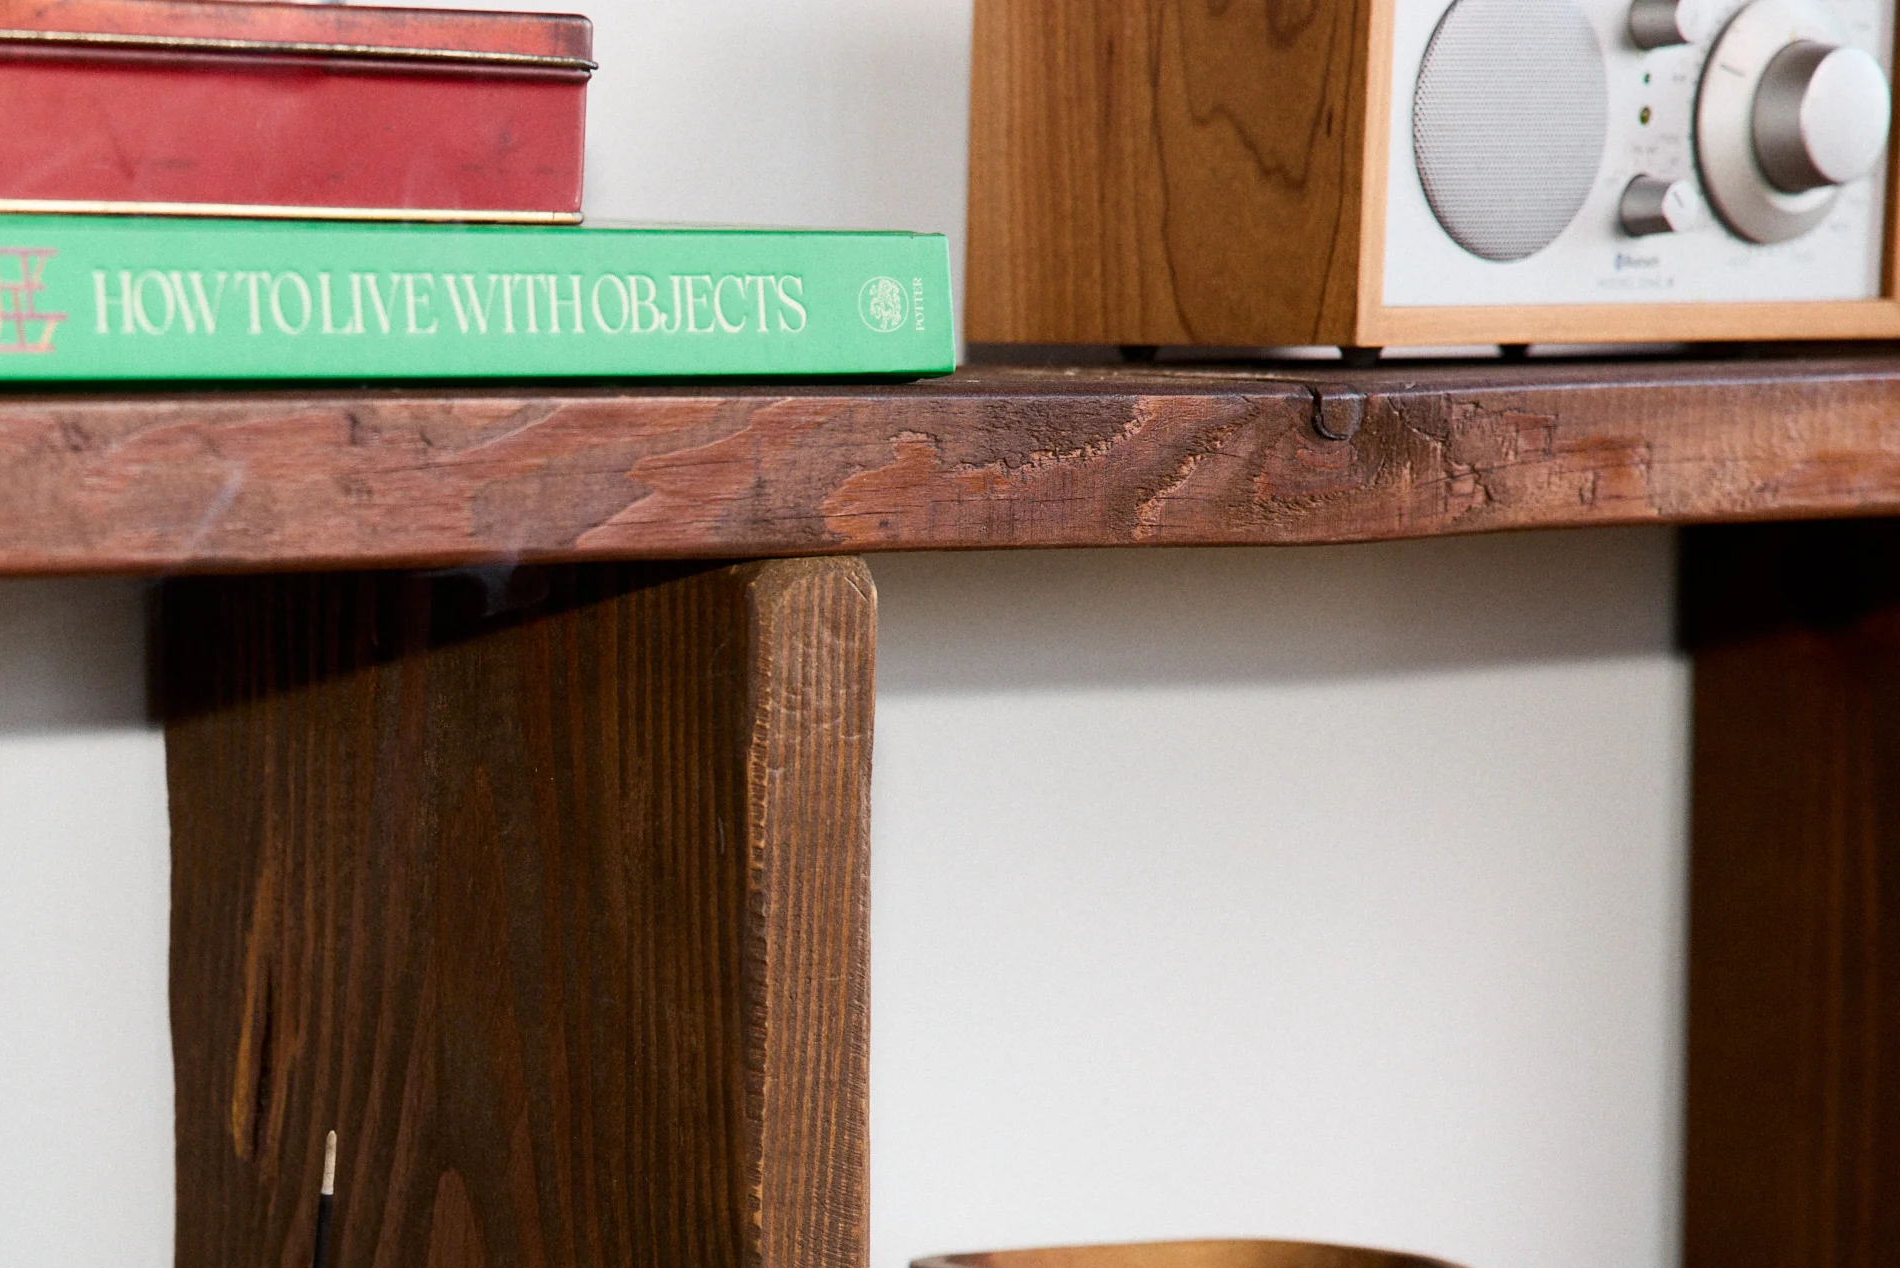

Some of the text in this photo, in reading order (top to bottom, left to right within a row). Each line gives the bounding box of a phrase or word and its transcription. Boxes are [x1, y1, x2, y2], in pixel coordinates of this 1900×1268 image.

[91, 267, 807, 336] HOW TO LIVE WITH OBJECTS
[911, 276, 926, 332] POTTER
